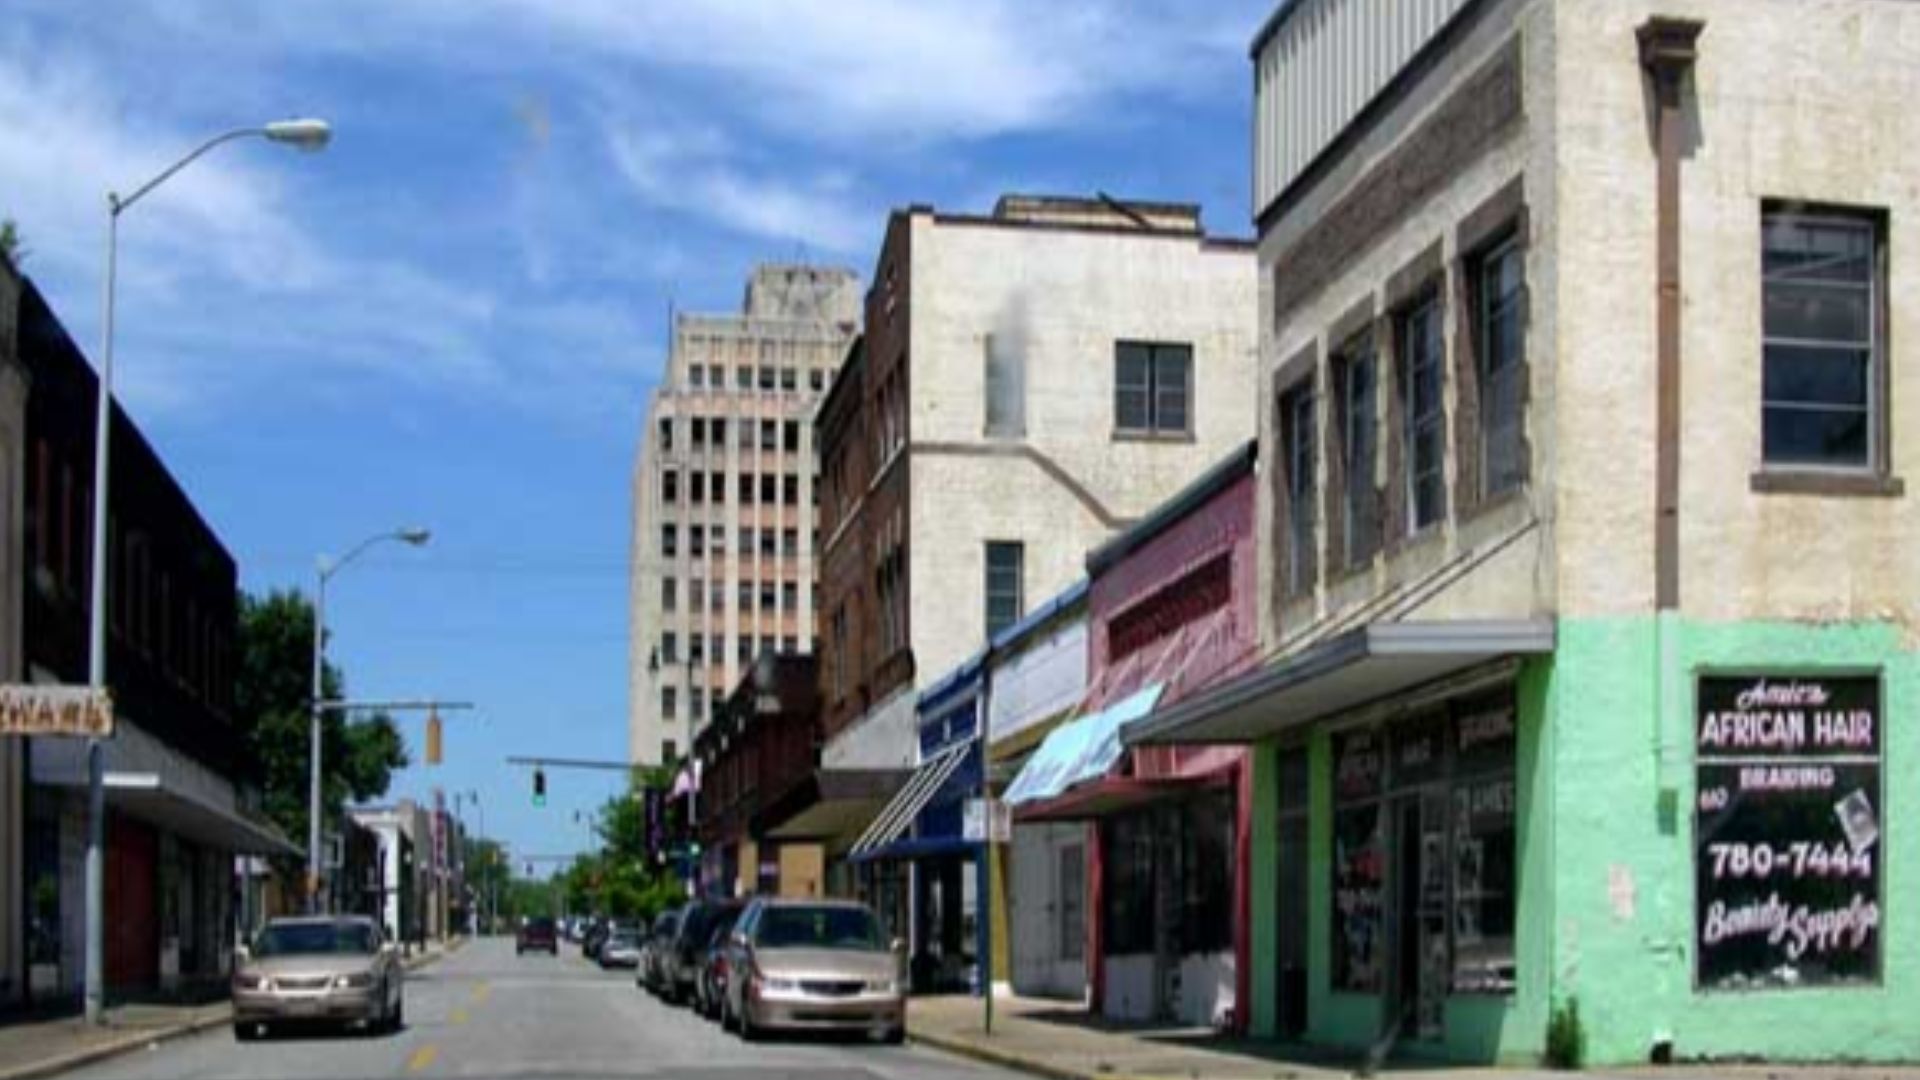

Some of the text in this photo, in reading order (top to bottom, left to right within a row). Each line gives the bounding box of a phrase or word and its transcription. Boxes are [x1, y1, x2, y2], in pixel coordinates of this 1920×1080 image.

[1701, 711, 1872, 745] AFRICAN HAIR
[1740, 767, 1835, 789] BRAIDING
[1709, 842, 1872, 878] 780-7444
[1703, 891, 1789, 944] Beauty
